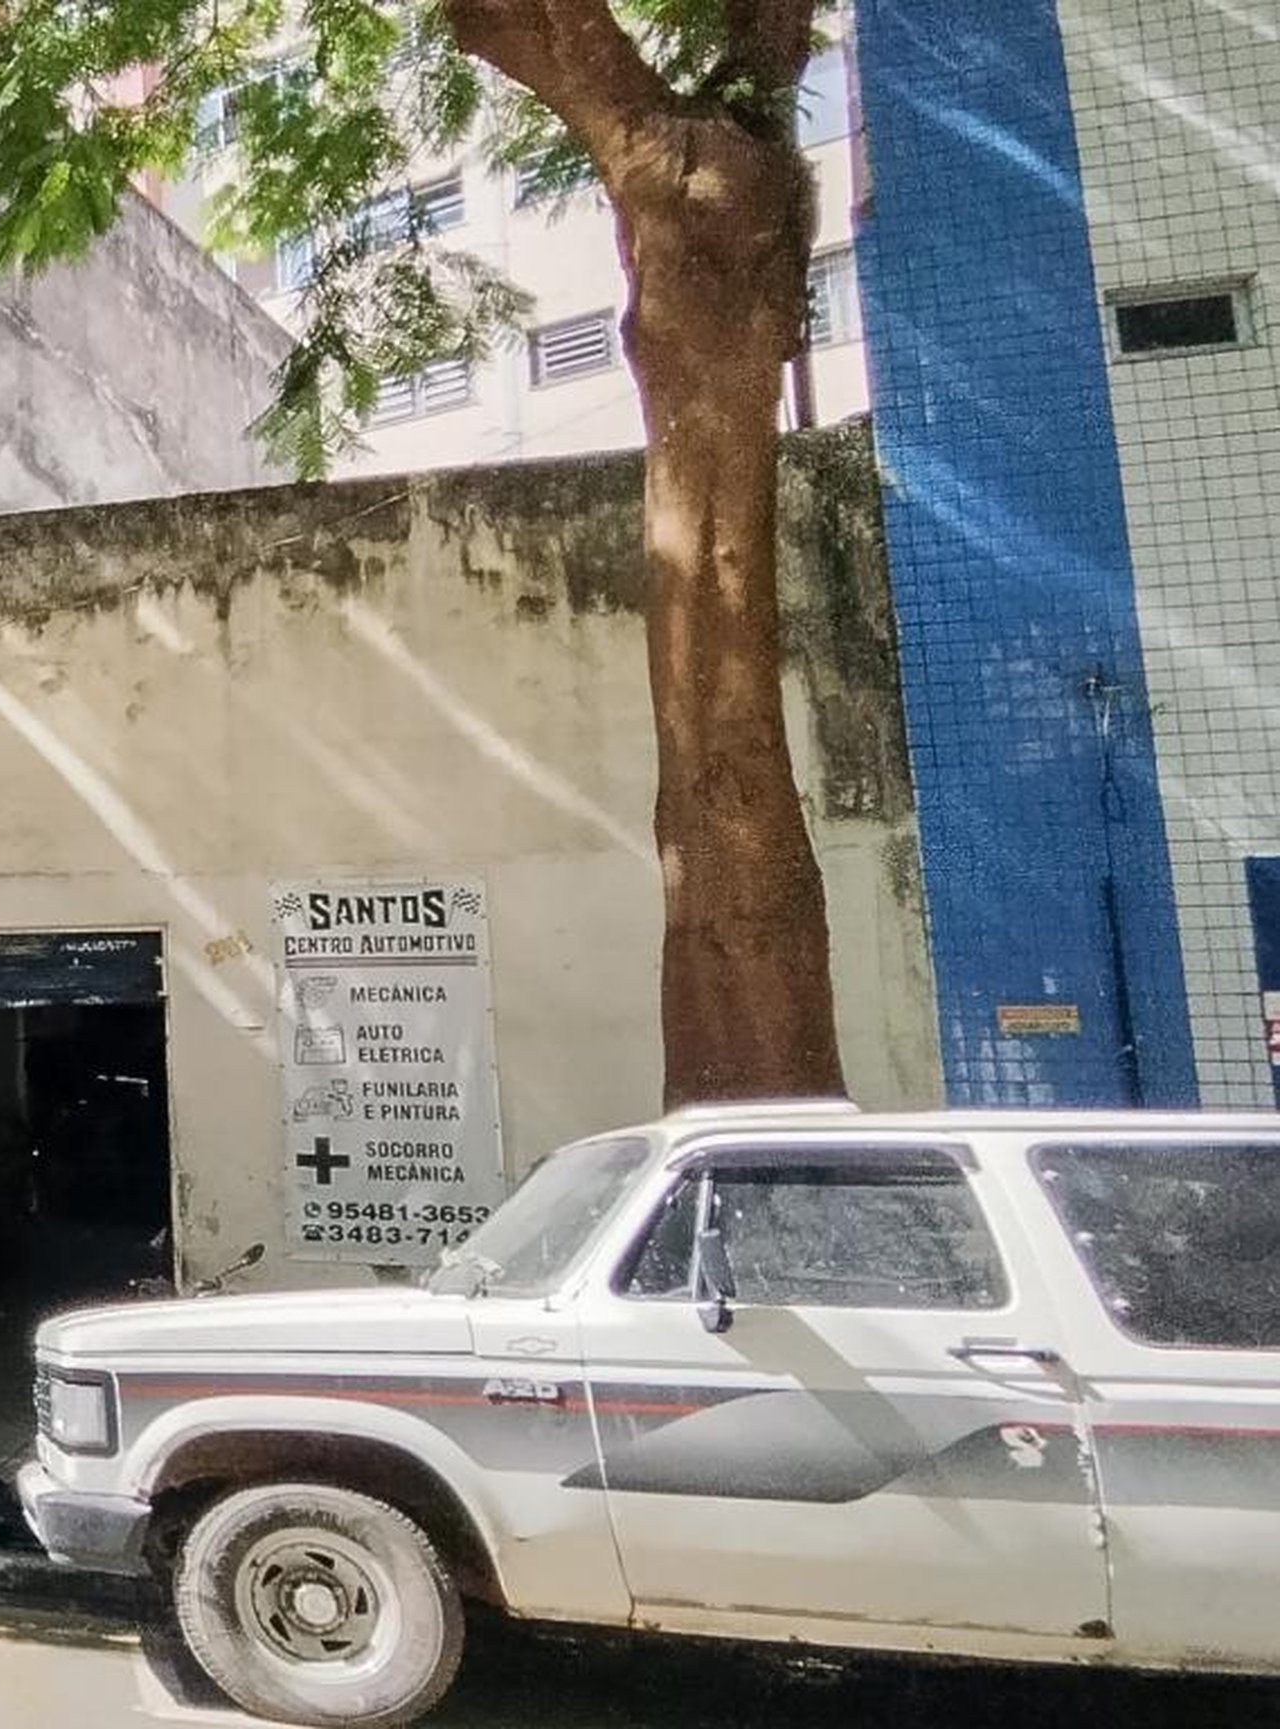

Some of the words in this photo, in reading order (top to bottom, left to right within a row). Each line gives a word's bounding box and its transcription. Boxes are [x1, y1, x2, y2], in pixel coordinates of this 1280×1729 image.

[309, 890, 446, 930] SANTOS
[285, 936, 352, 956] CENTRO
[360, 934, 476, 955] AUTOMOTIVO
[357, 1025, 403, 1041] AUTO
[362, 1082, 459, 1098] FUNILARIA
[364, 1104, 375, 1120] E
[381, 1104, 460, 1121] PINTURA
[365, 1141, 454, 1159] SOCORRO
[367, 1163, 466, 1183] MECÂNICA
[327, 1202, 491, 1224] 95481-3653
